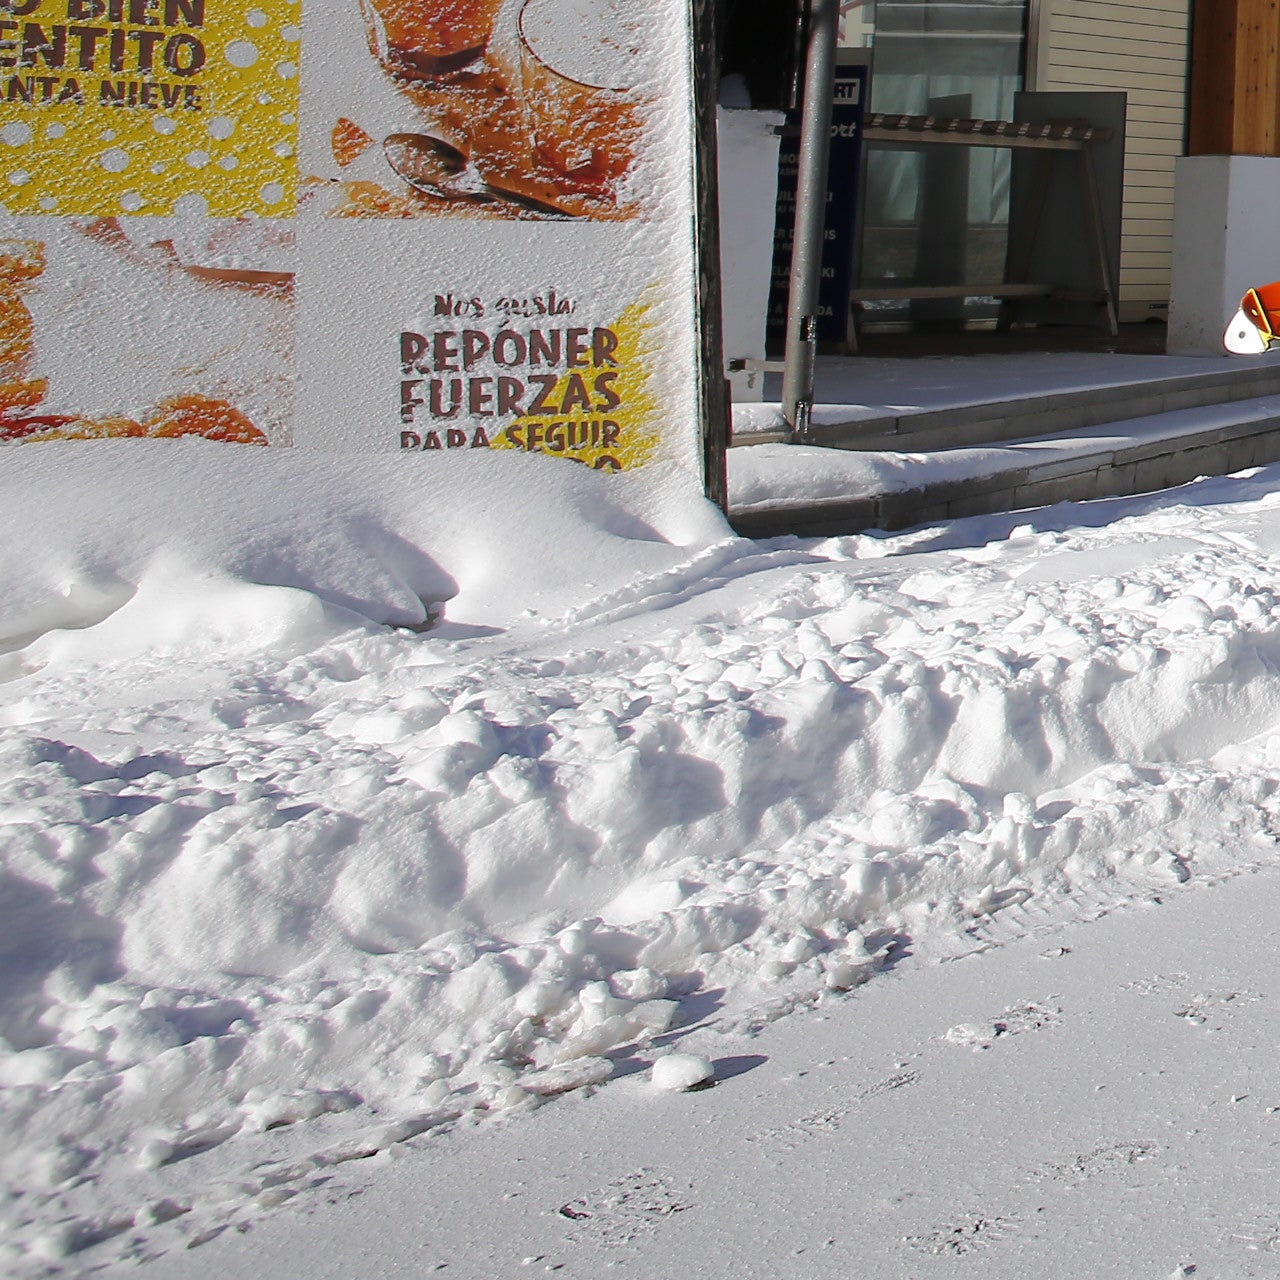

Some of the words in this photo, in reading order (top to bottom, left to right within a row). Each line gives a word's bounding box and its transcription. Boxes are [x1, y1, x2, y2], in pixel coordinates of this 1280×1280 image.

[100, 80, 204, 112] NIEVE
[433, 293, 485, 318] Nos
[401, 371, 623, 423] FUERZAS
[504, 420, 623, 452] SEGUIR
